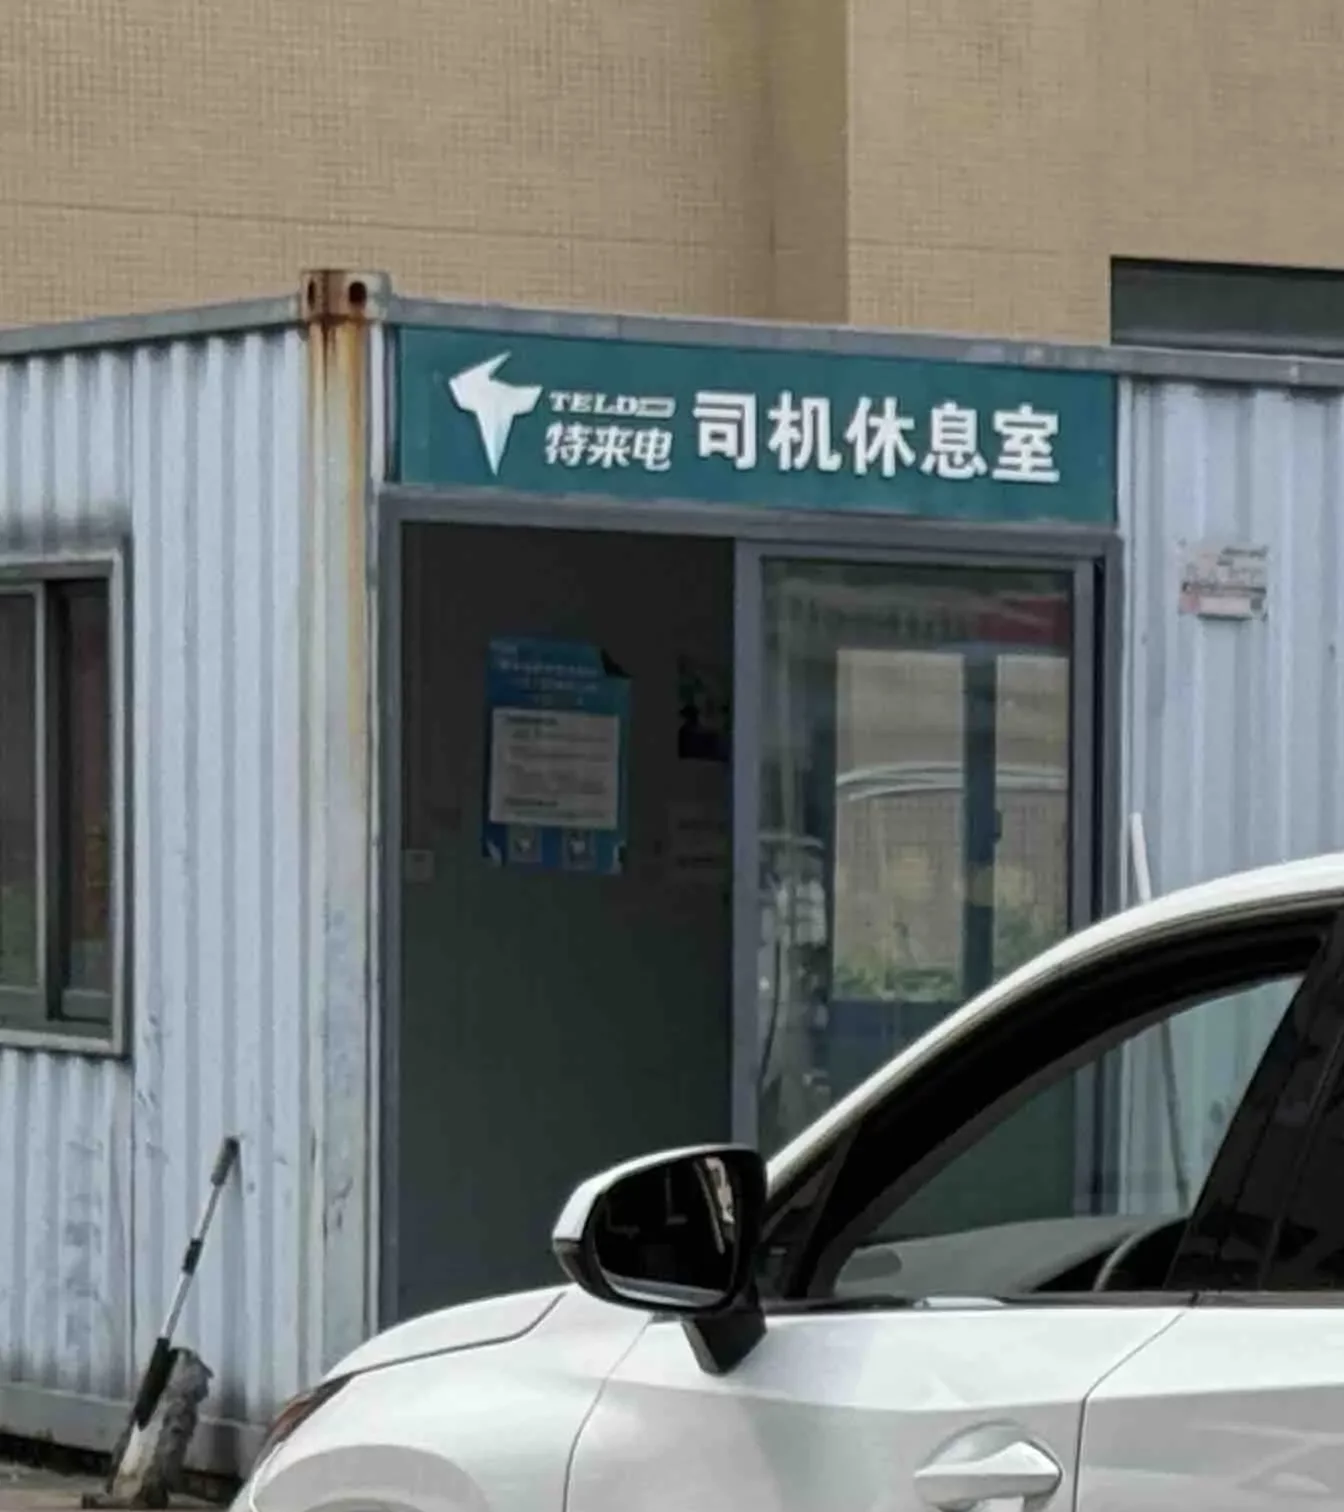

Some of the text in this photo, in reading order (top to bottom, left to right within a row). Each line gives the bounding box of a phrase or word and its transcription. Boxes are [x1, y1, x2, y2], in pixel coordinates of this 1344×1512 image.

[545, 421, 673, 472] 特来电
[693, 390, 1060, 483] 司机休息室
